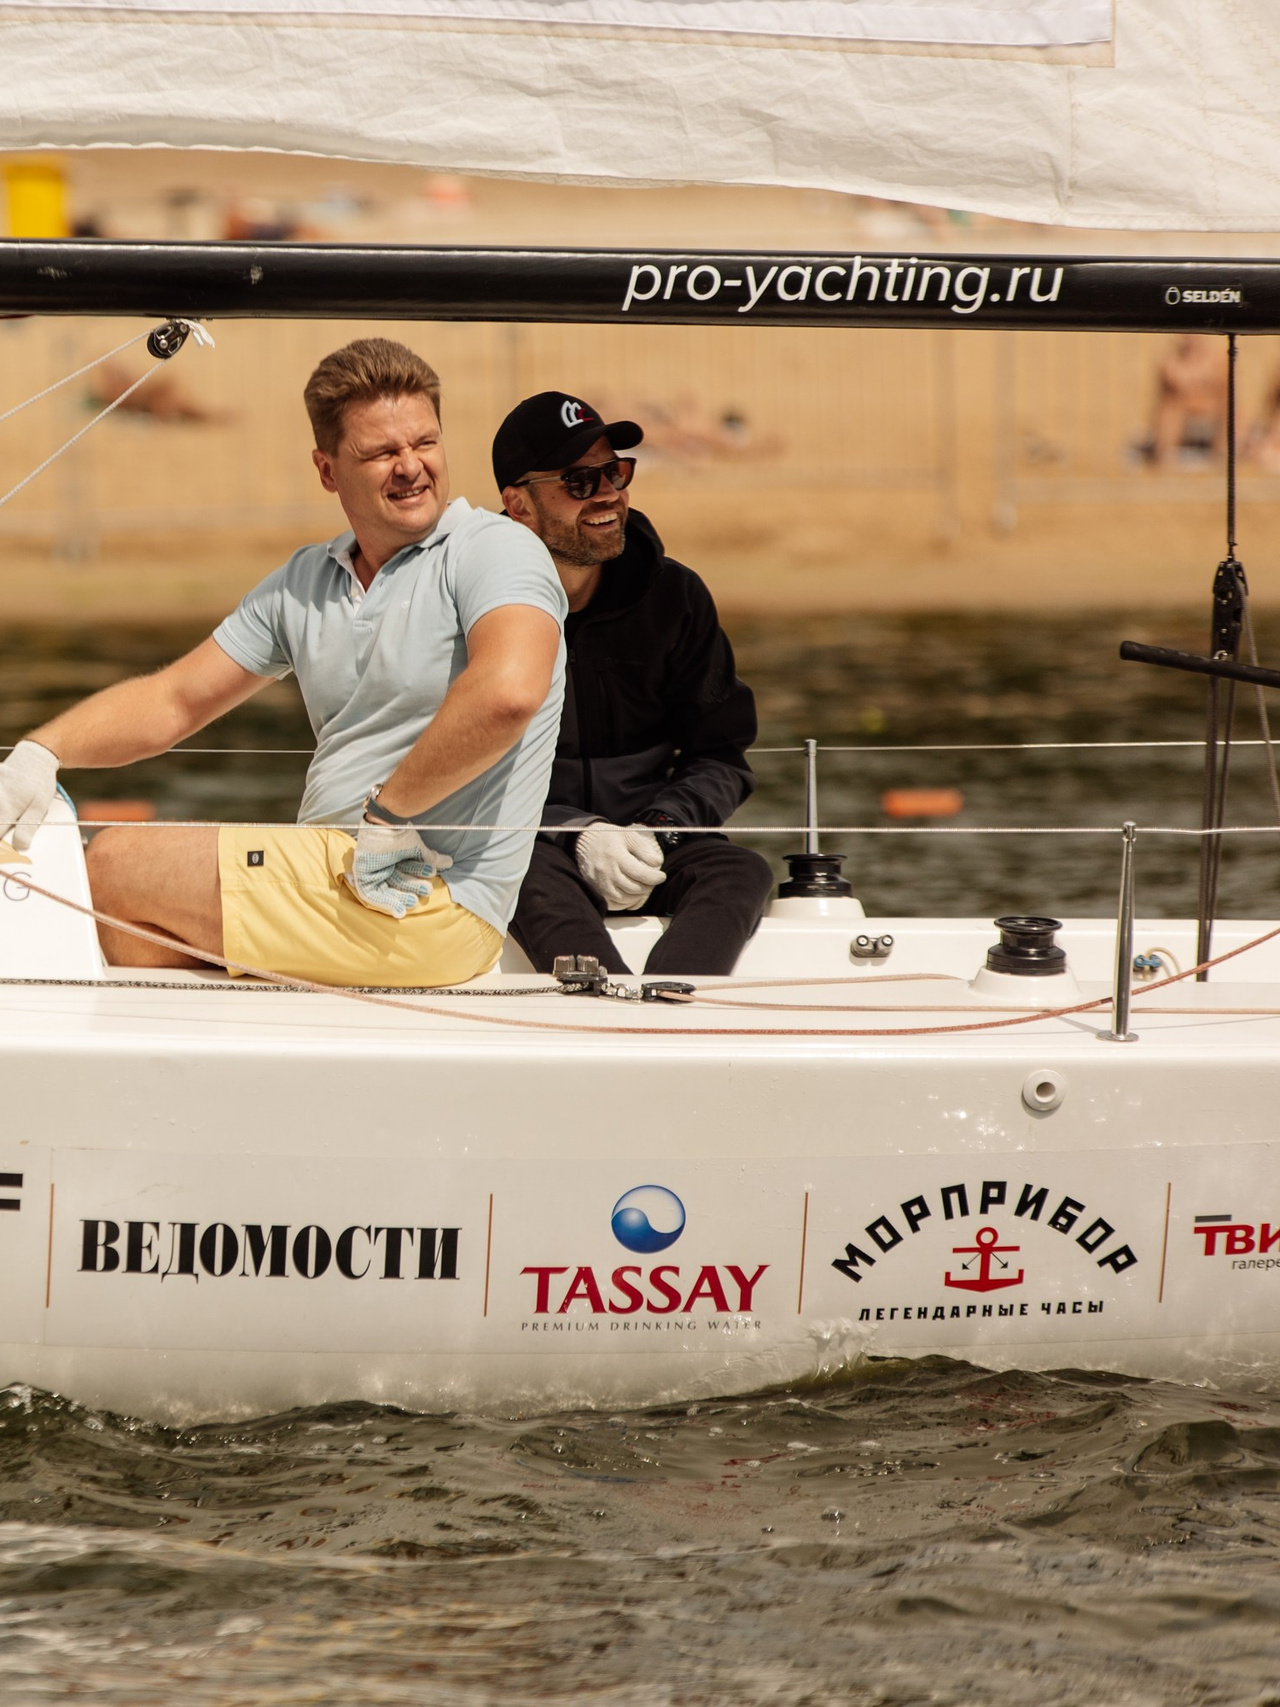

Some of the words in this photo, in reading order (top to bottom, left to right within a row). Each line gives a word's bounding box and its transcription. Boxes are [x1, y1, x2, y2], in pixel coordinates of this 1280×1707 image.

[622, 256, 1064, 314] pro-yachting.ru
[1182, 288, 1241, 303] SELDÉN
[77, 1219, 463, 1284] ВЕДОМОСТИ
[831, 1181, 1138, 1283] МОРПРИБОР
[520, 1264, 771, 1314] TASSAY
[858, 1304, 1029, 1321] ЛЕГЕНДАРНЫЕ
[1041, 1300, 1105, 1316] ЧАСЫ
[521, 1321, 599, 1332] PREMIUM
[610, 1320, 697, 1332] DRINKING
[708, 1320, 762, 1331] WATER
